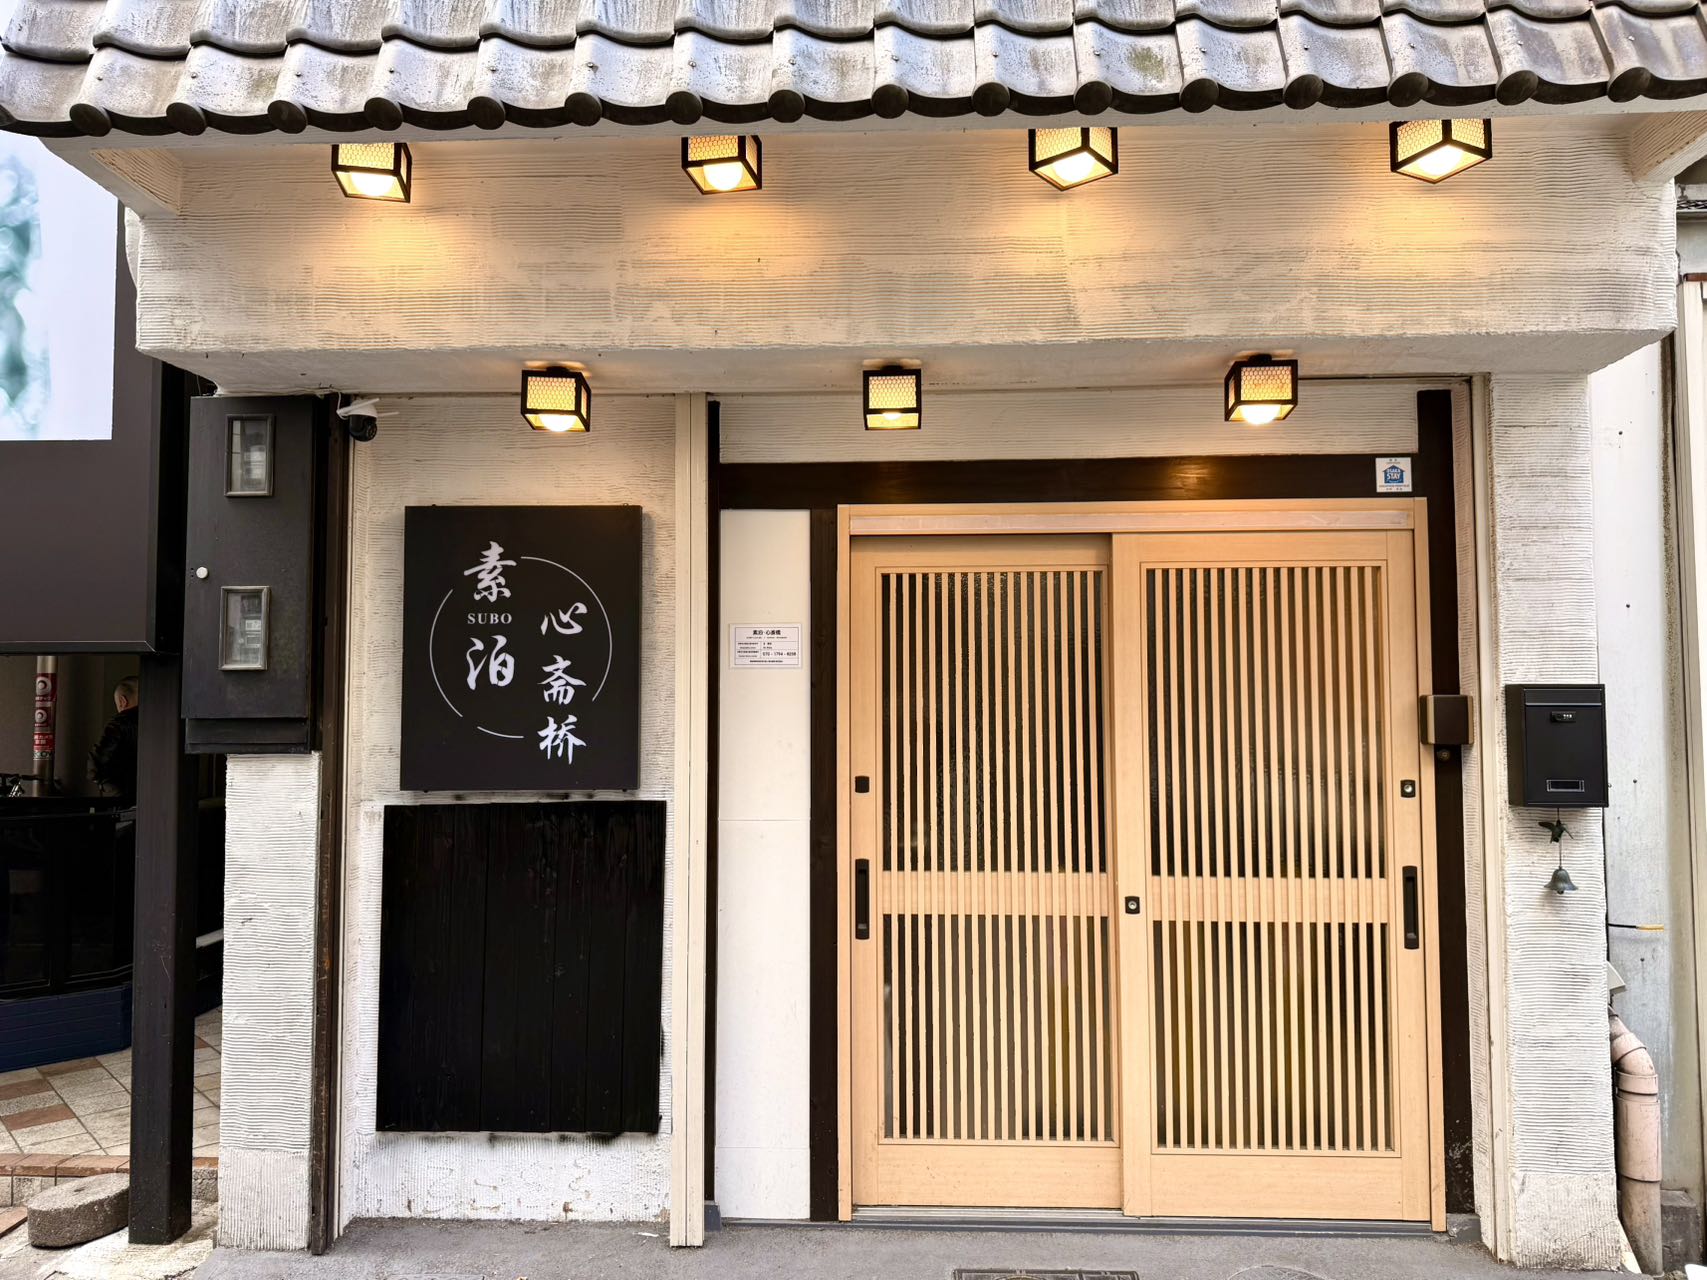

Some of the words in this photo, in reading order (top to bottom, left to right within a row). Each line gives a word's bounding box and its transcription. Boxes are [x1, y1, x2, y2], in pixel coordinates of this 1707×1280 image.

[463, 541, 517, 603] 素
[467, 612, 512, 625] SUBO
[465, 634, 515, 691] 泊
